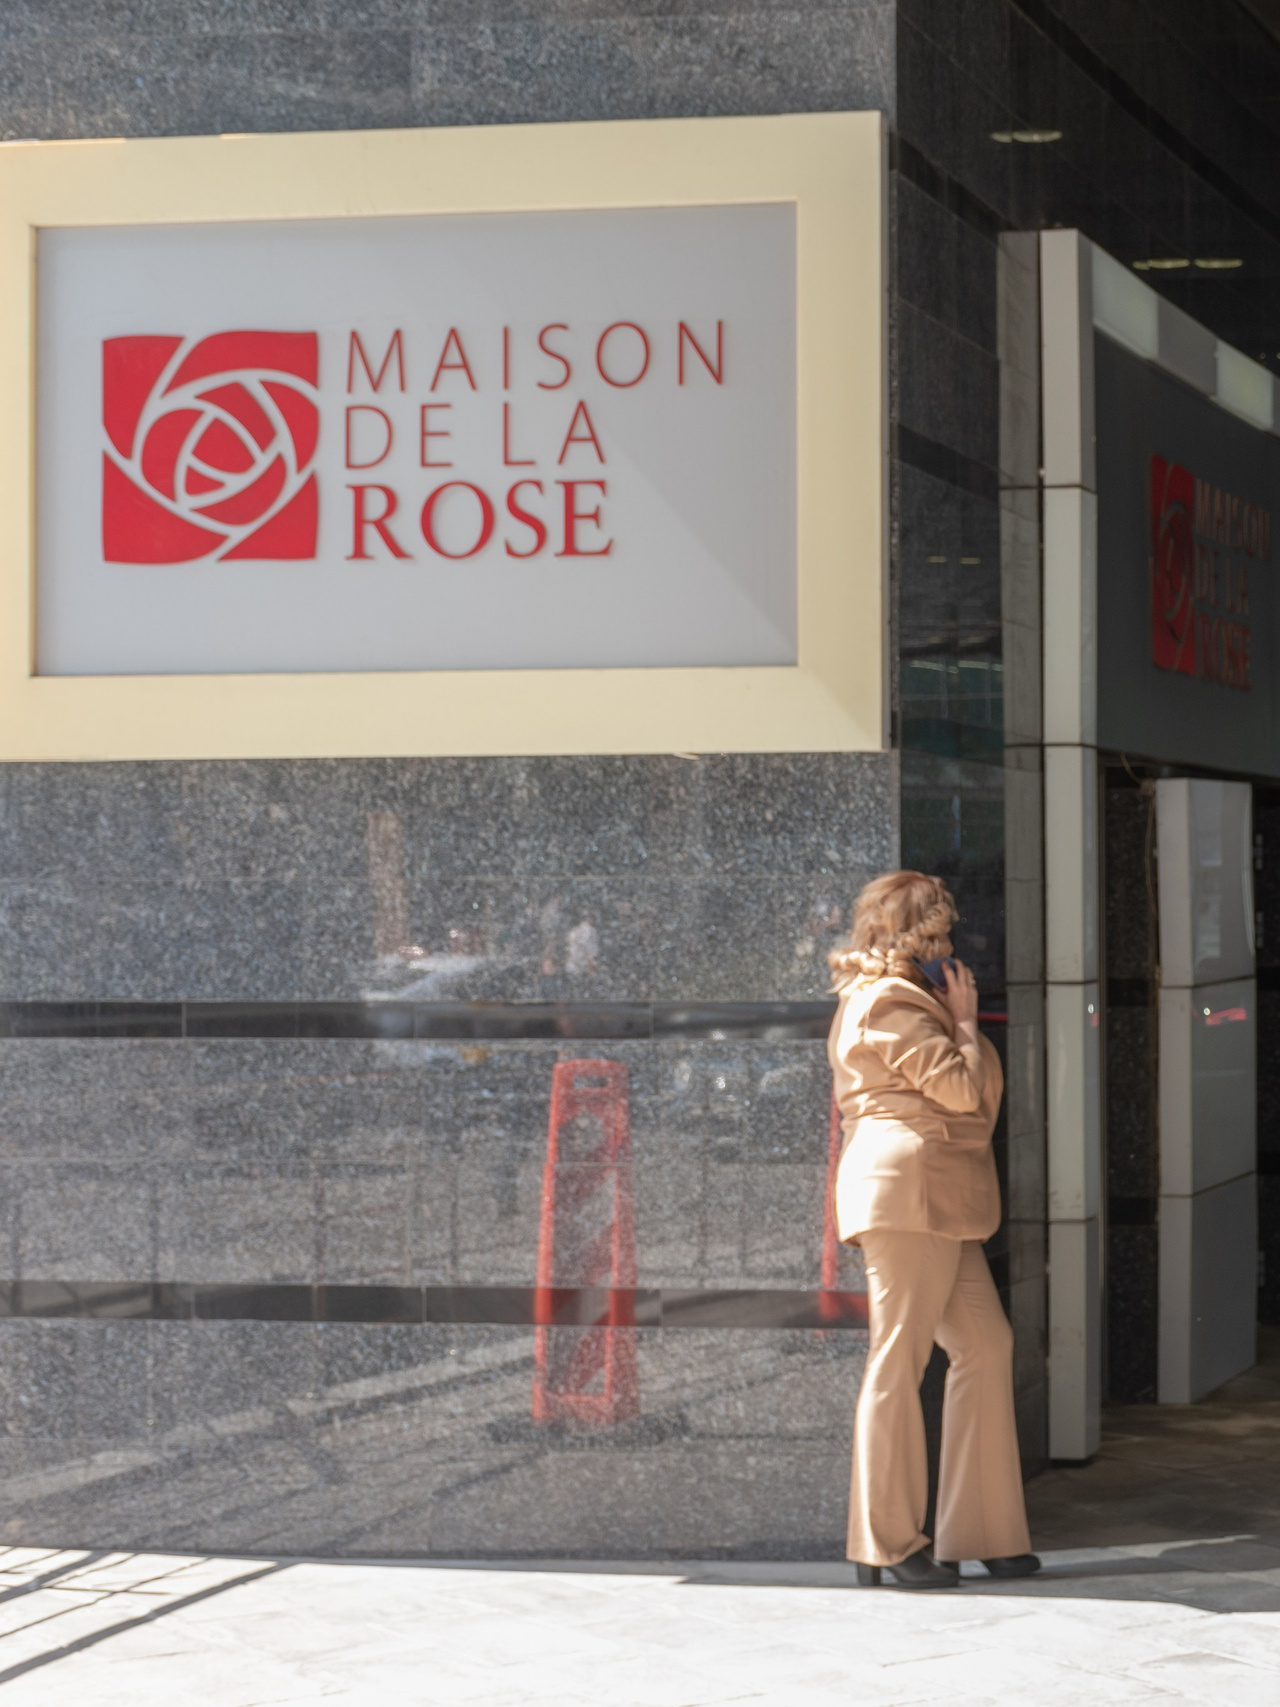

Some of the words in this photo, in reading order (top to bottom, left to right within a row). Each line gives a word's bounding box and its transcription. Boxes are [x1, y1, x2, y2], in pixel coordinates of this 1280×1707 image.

[346, 319, 724, 394] MAISON
[344, 402, 453, 471] DE
[502, 399, 607, 468] LA
[345, 479, 614, 561] ROSE
[1195, 477, 1271, 561] MAISON
[1195, 543, 1220, 607] DE
[1225, 556, 1251, 617] LA
[1197, 611, 1253, 692] ROSE
